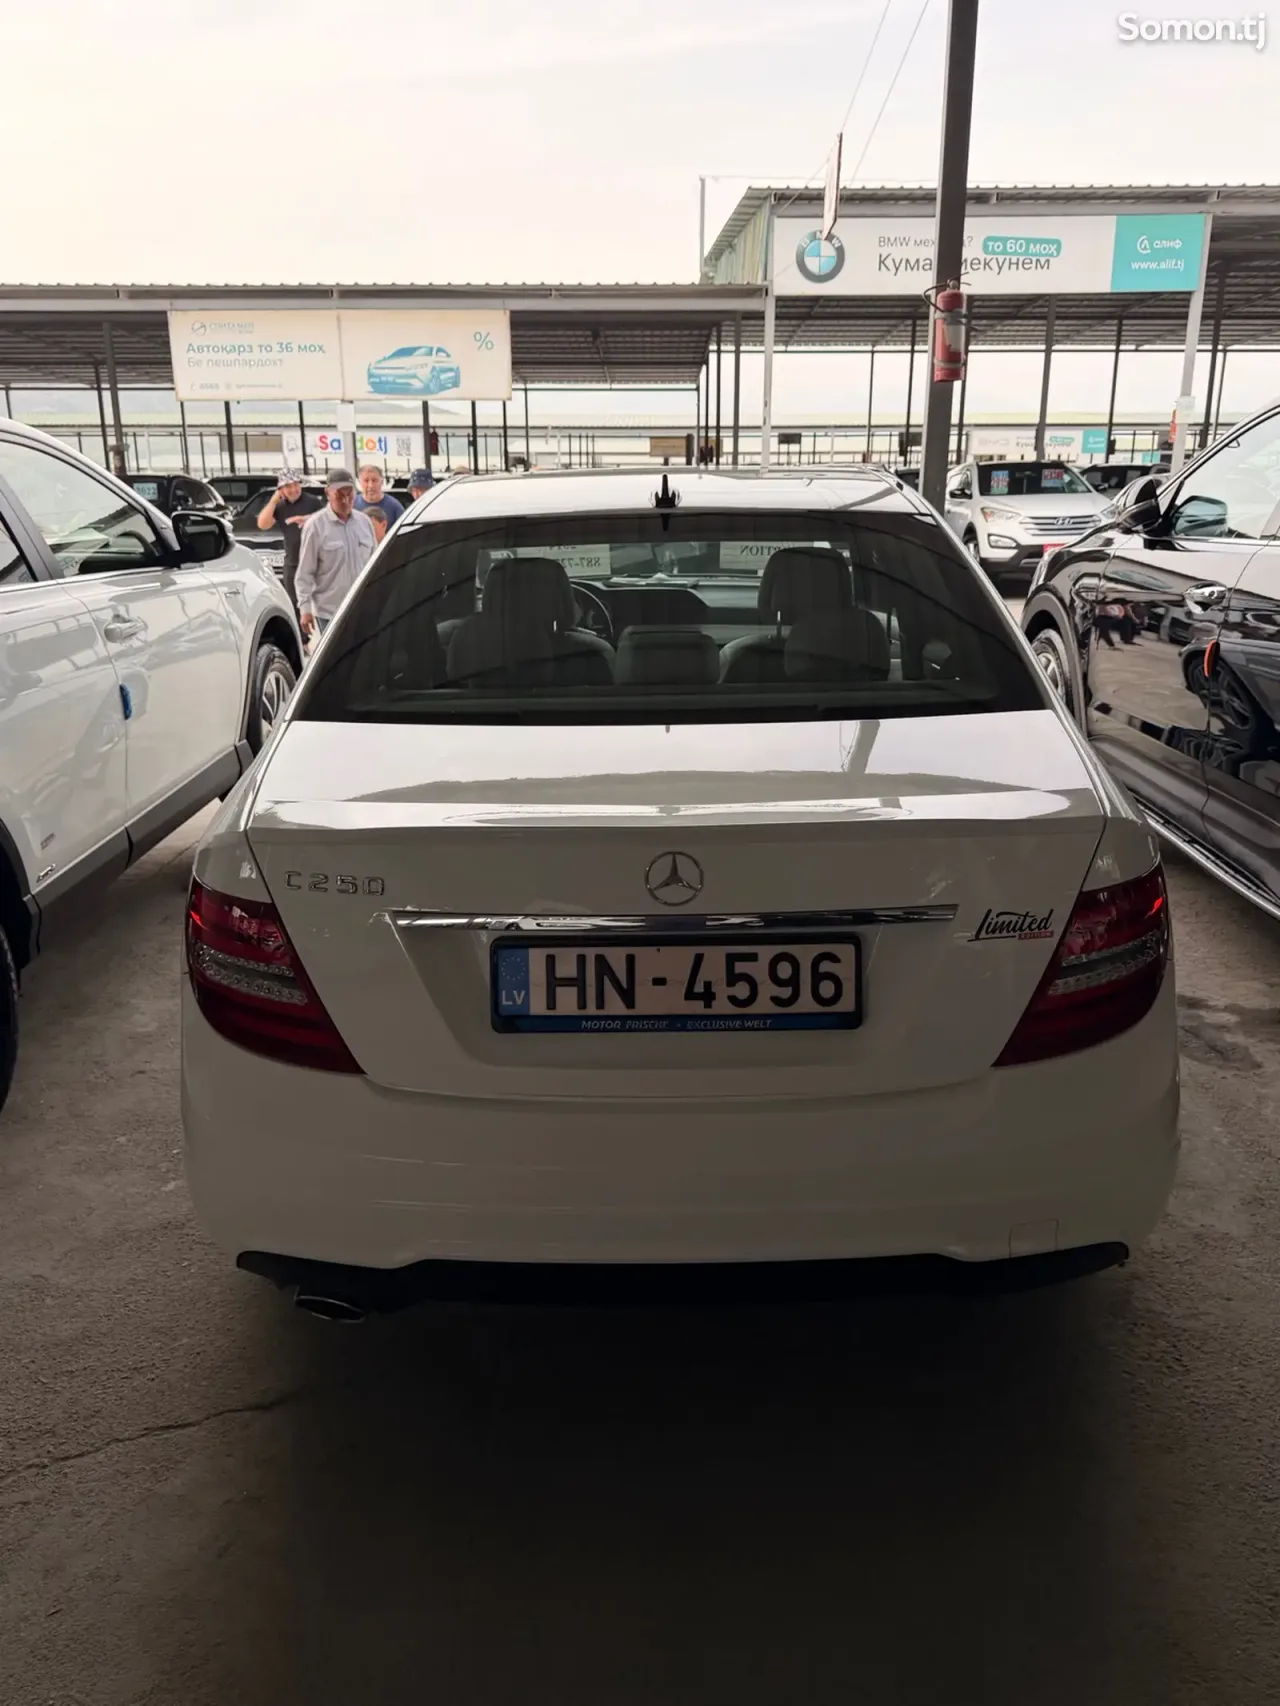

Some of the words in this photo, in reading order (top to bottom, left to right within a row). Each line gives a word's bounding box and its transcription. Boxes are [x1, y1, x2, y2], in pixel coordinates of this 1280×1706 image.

[878, 236, 910, 248] BMW
[987, 241, 1003, 252] то
[1006, 239, 1025, 253] 60
[1153, 239, 1182, 249] алиф
[1131, 259, 1184, 272] www.alif.tj
[258, 344, 273, 354] то
[276, 342, 294, 354] 36
[969, 908, 1054, 942] Limited
[502, 990, 526, 1005] LV
[581, 1020, 621, 1030] MOTOR
[687, 1020, 743, 1030] EXCLUSIVE
[744, 1019, 772, 1029] WELT
